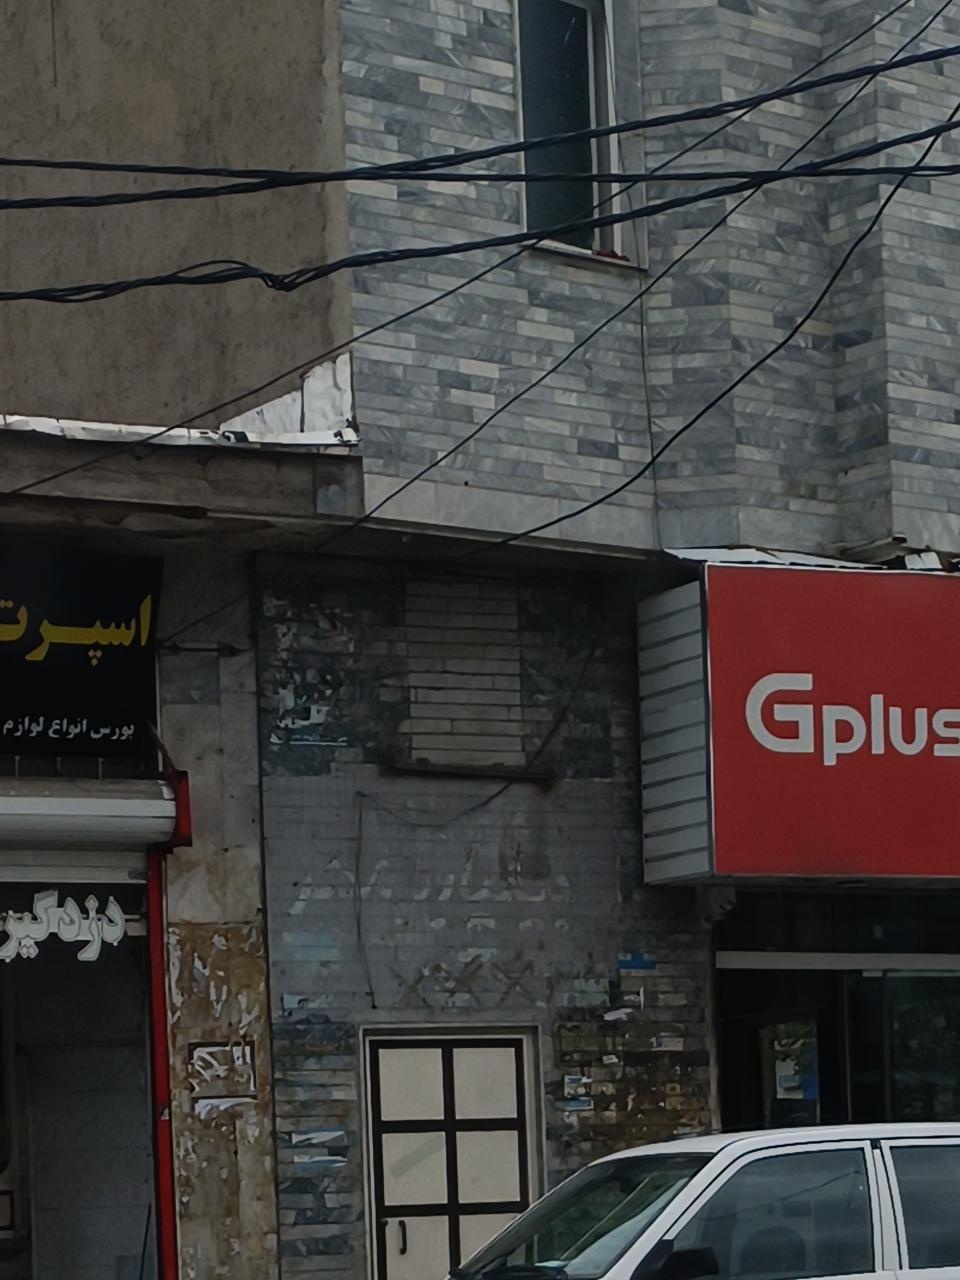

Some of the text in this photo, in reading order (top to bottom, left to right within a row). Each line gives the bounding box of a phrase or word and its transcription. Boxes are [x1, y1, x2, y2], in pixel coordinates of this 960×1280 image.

[3, 715, 135, 740] بورس انواع لوازم
[0, 890, 125, 962] دزدگیر
